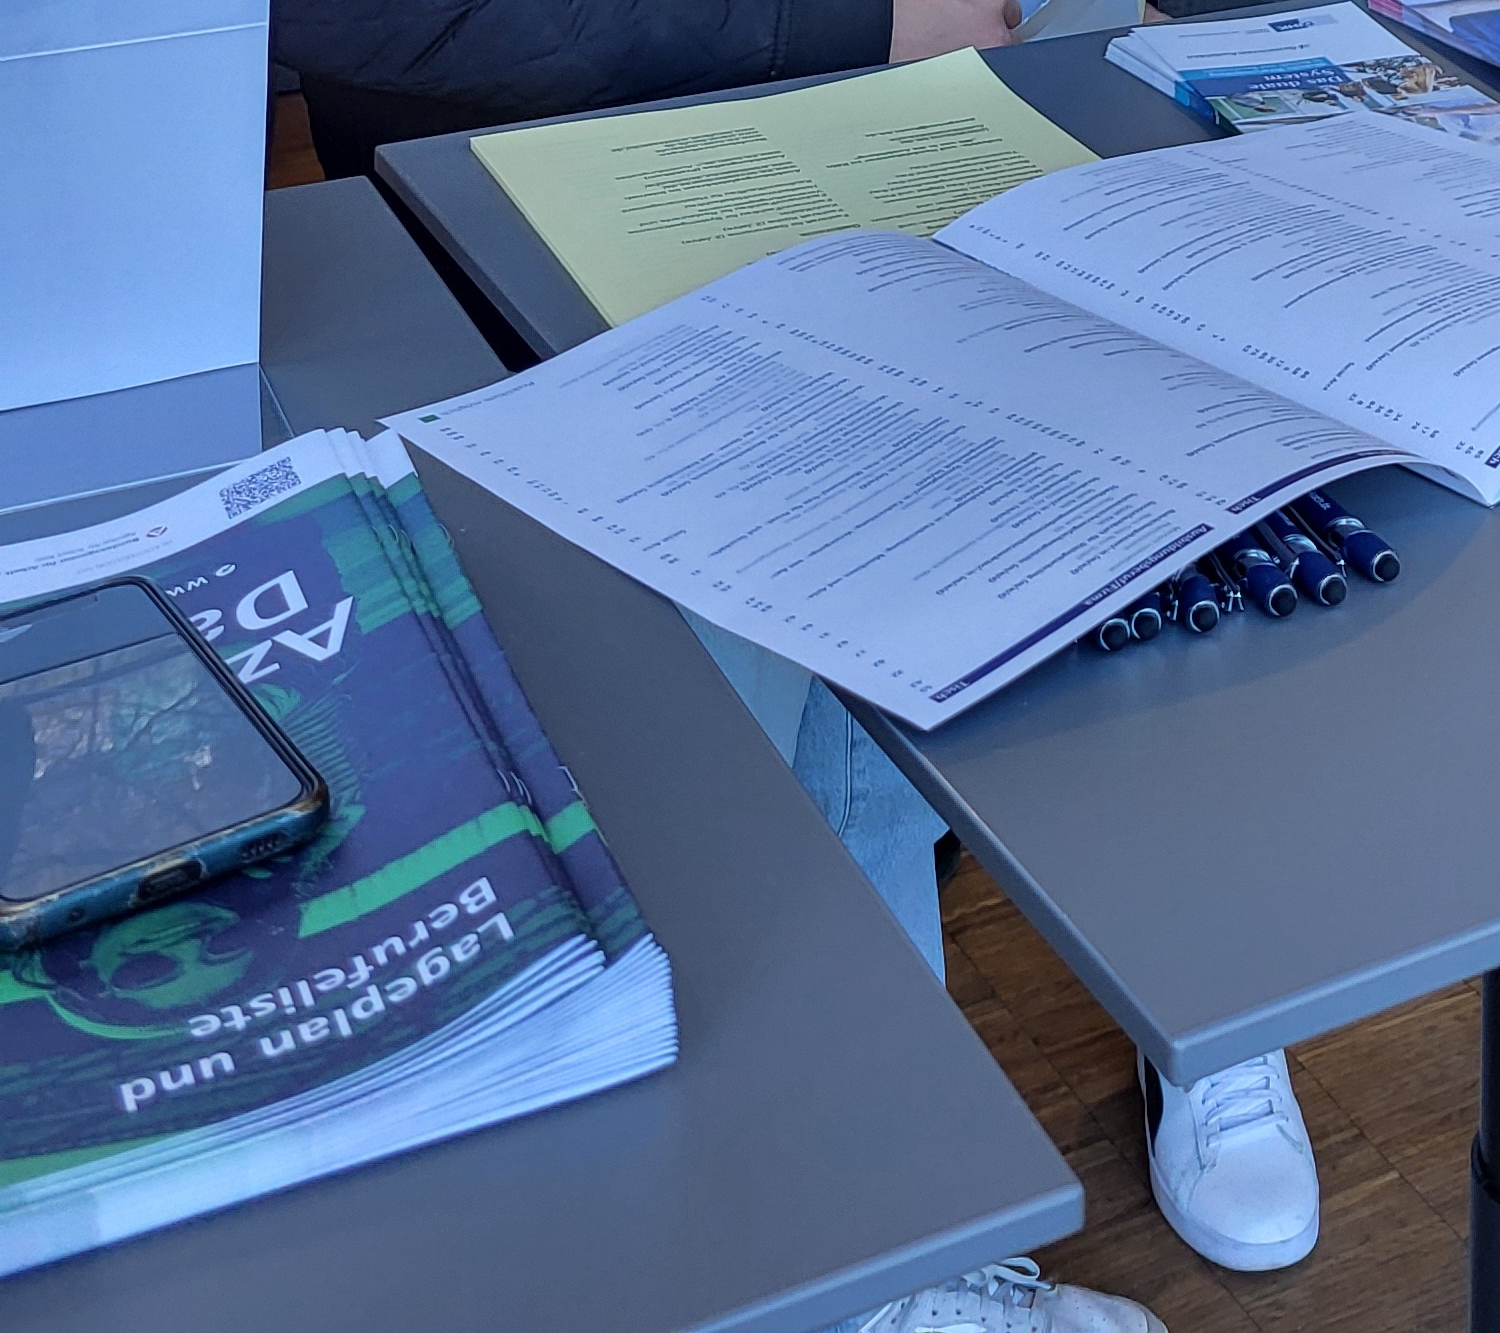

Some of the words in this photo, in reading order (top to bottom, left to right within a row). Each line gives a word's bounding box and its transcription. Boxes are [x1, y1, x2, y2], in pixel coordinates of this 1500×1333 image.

[188, 876, 498, 1039] Berufeliste
[259, 912, 515, 1059] Lageplan
[120, 1050, 237, 1113] und
